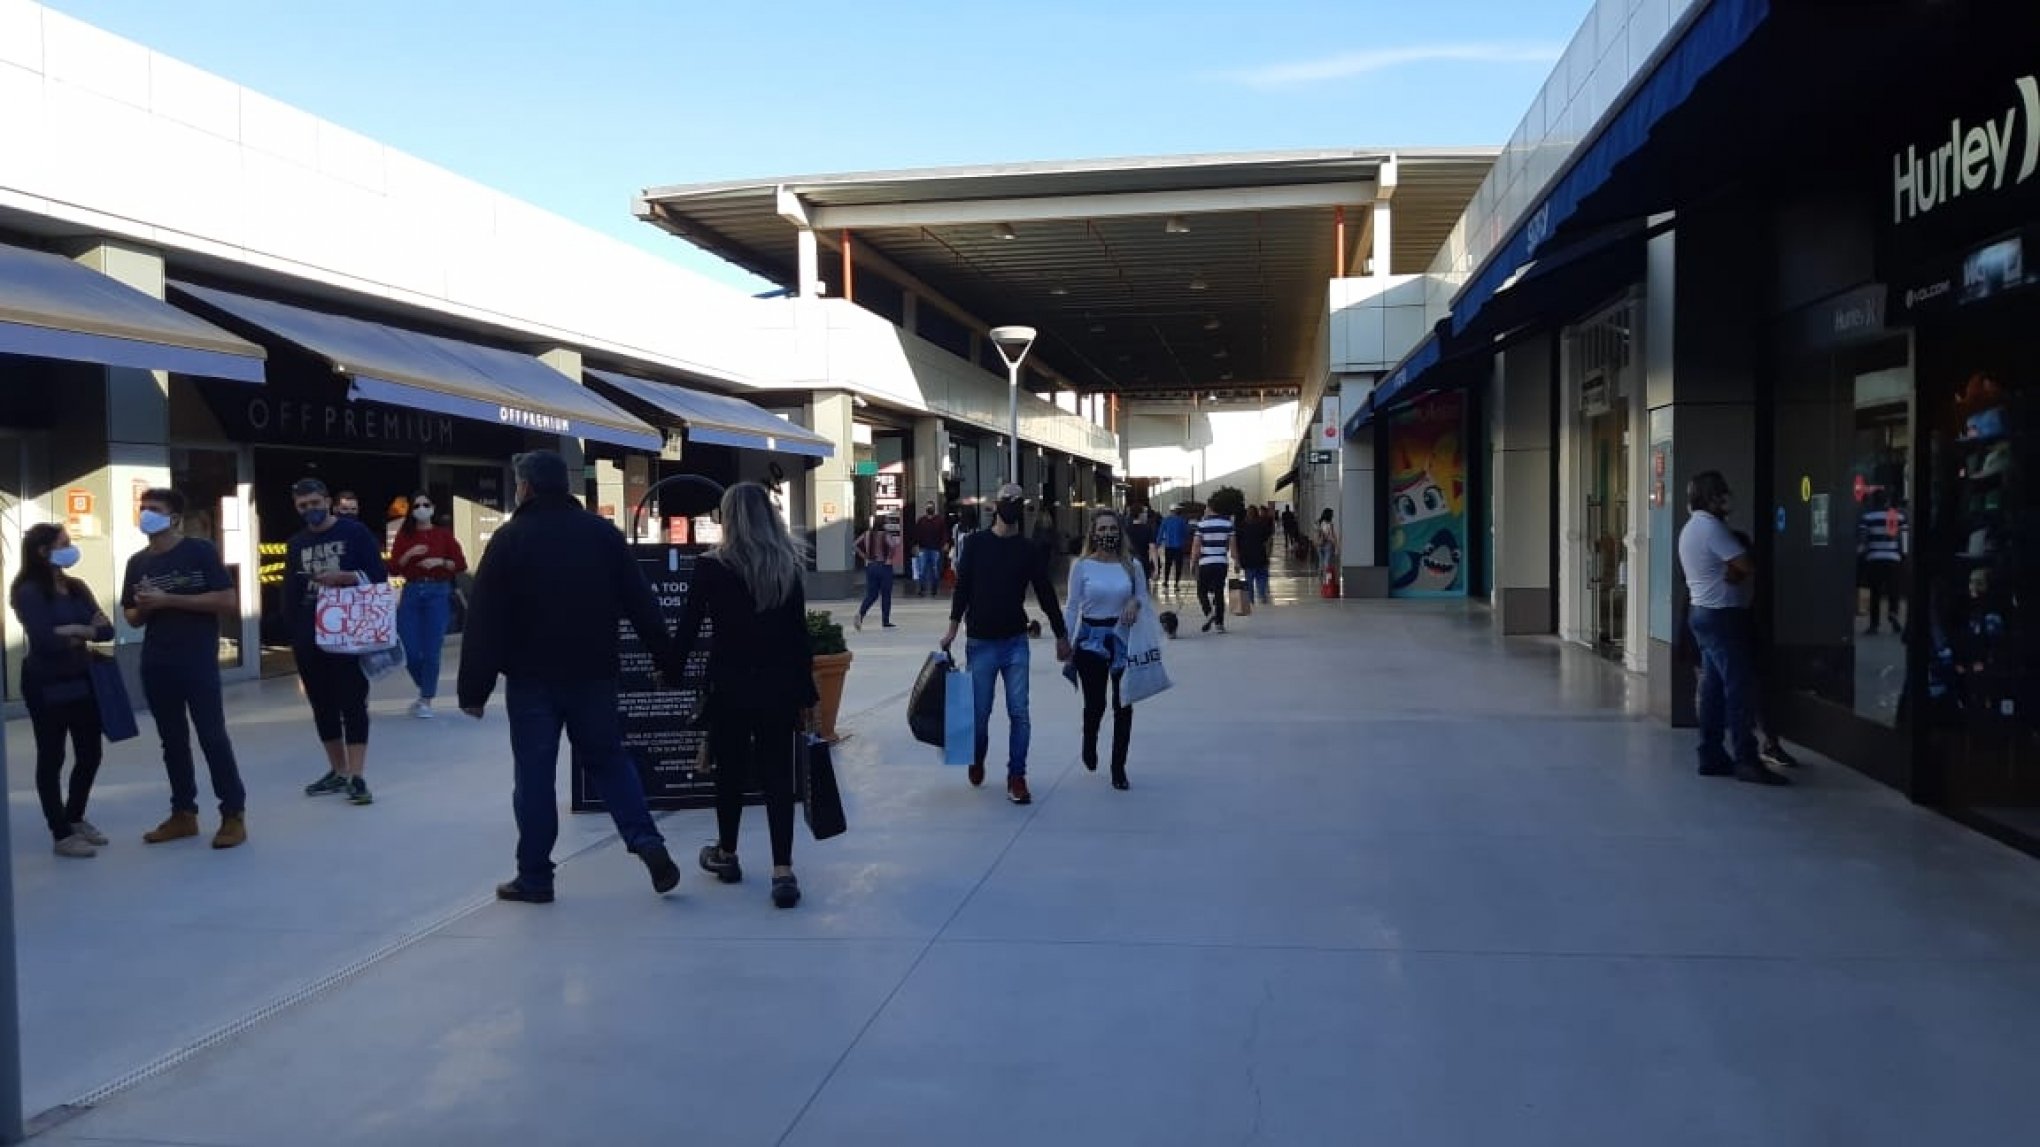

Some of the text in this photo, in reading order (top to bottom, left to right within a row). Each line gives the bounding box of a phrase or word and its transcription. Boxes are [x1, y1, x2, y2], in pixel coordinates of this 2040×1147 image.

[1893, 107, 2016, 225] Hurley
[247, 398, 454, 448] OFF PREMIUM
